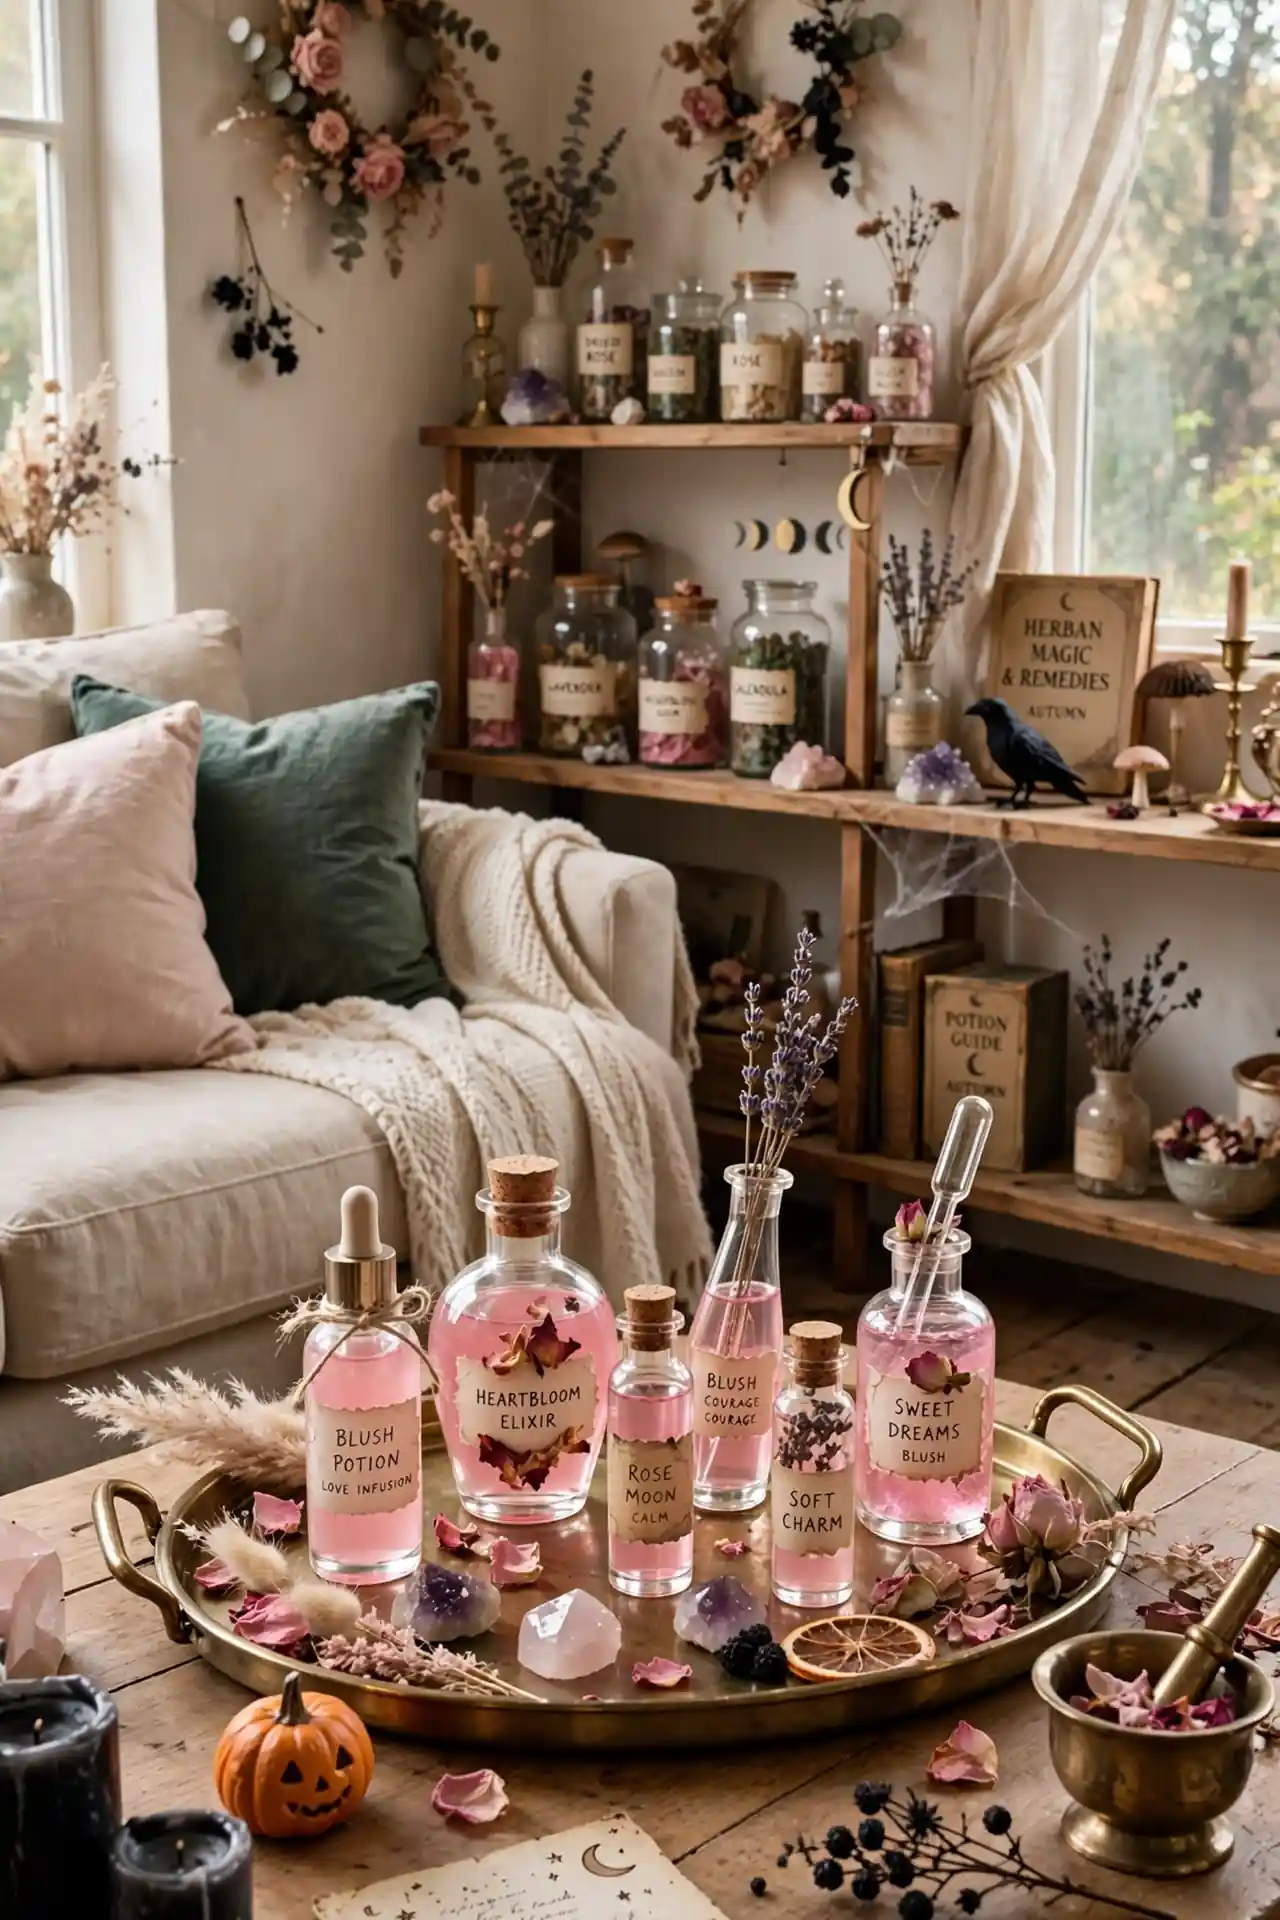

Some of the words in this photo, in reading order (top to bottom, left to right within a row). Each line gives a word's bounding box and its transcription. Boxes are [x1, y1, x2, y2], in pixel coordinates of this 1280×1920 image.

[1023, 617, 1104, 639] HERBAN
[1030, 642, 1093, 665] MAGIC
[1001, 666, 1015, 687] &
[1019, 668, 1110, 691] REMEDIES
[1026, 704, 1087, 720] AUTUMN
[945, 1011, 1008, 1033] POTION
[950, 1032, 1005, 1052] GUIDE
[708, 1372, 757, 1391] BLUSH
[476, 1386, 581, 1408] HEARTBLOOM
[704, 1395, 760, 1409] COURAGE
[894, 1398, 955, 1418] SWEET
[500, 1414, 557, 1430] ELIXIR
[704, 1412, 757, 1426] COURAGE
[336, 1426, 395, 1447] BLUSH
[888, 1422, 961, 1442] DREAMS
[333, 1450, 400, 1473] POTION
[901, 1449, 946, 1464] BLUSH
[628, 1464, 672, 1483] ROSE
[321, 1481, 349, 1496] LOVE
[356, 1474, 412, 1495] INFUSION
[625, 1486, 676, 1504] MOON
[789, 1490, 836, 1510] SOFT
[632, 1511, 669, 1524] CALM
[781, 1512, 843, 1534] CHARM
